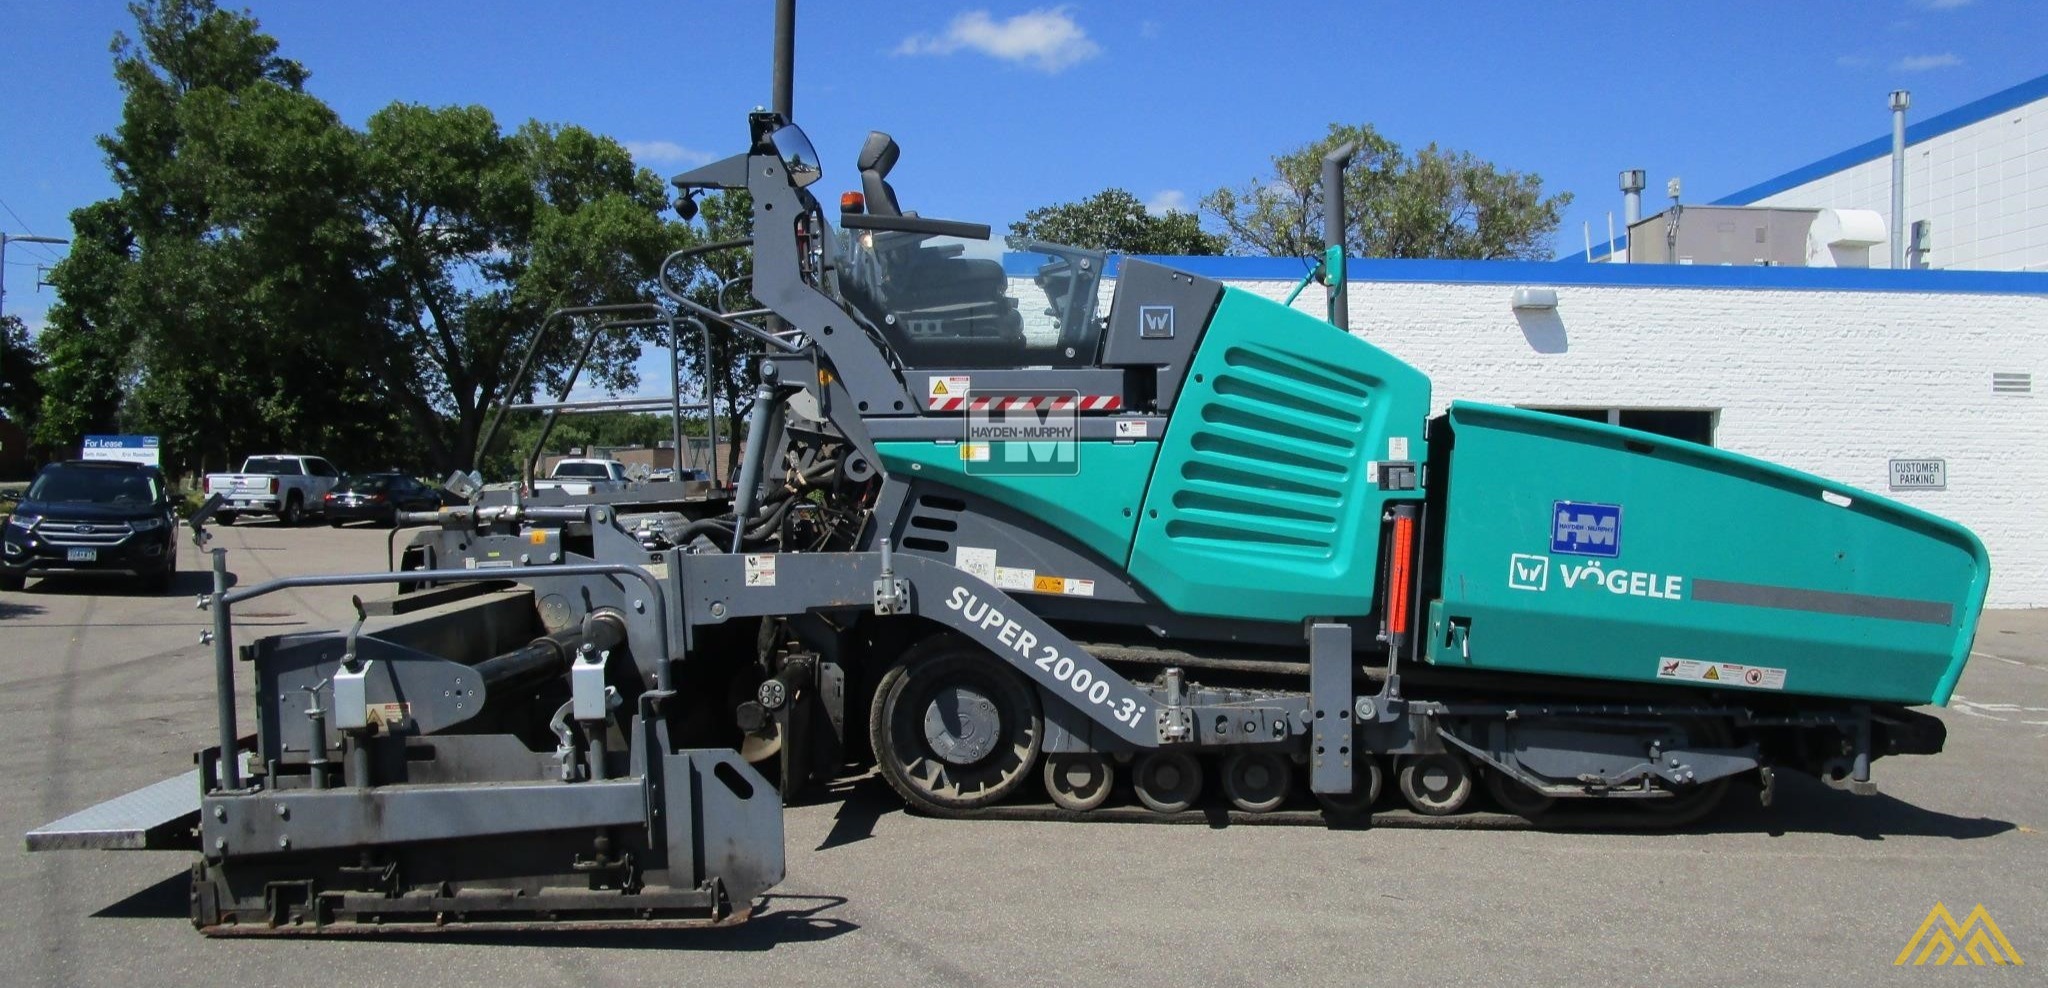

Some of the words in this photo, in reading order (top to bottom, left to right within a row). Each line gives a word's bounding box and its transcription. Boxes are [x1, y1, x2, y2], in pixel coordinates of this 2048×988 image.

[84, 439, 97, 448] For
[100, 439, 123, 448] Lease
[1895, 462, 1940, 473] CUSTOMER
[1900, 474, 1935, 484] PARKING
[945, 586, 1038, 659] SUPER
[1034, 646, 1147, 729] 2000-3i
